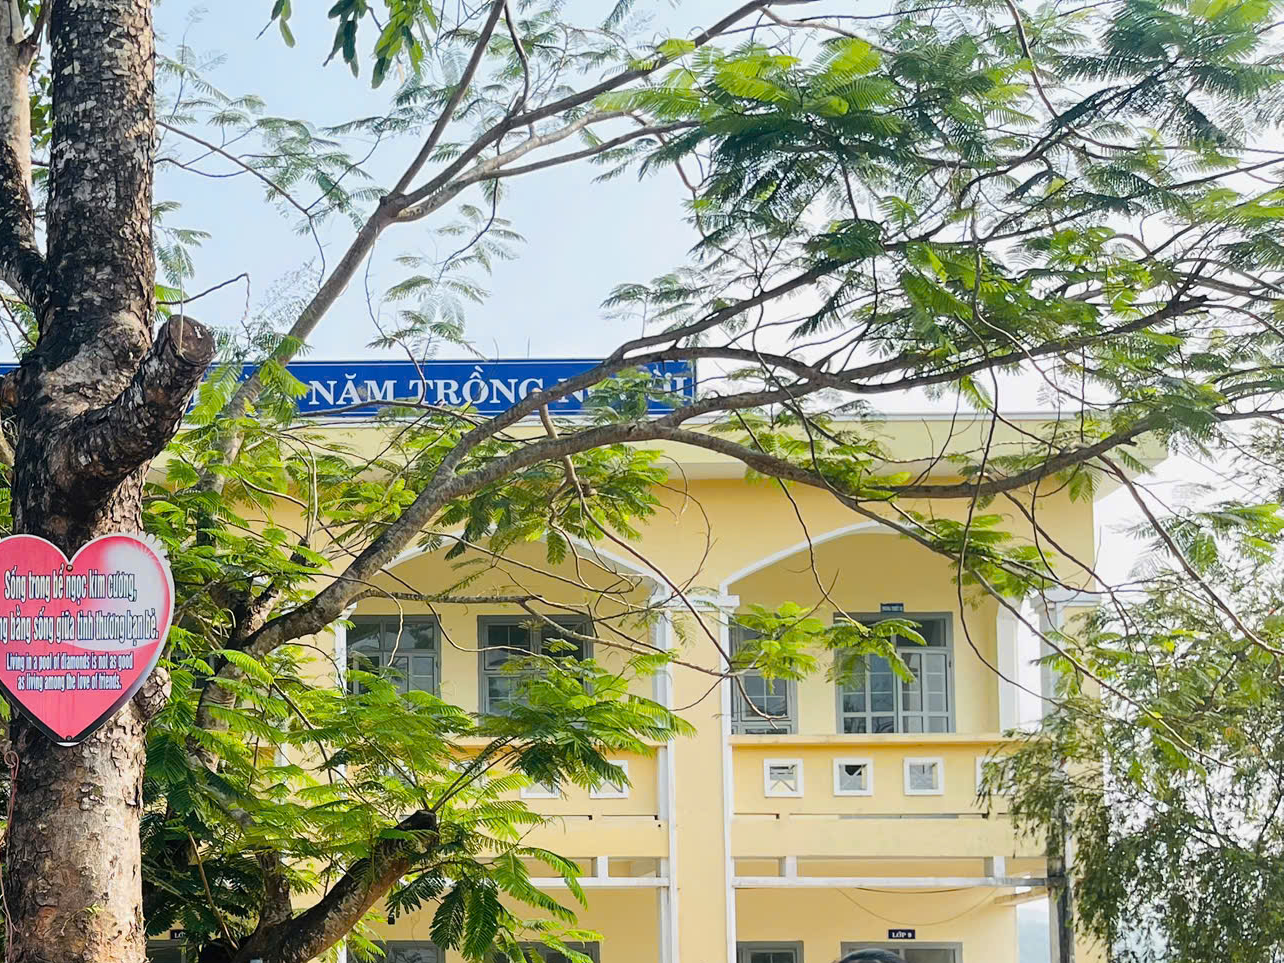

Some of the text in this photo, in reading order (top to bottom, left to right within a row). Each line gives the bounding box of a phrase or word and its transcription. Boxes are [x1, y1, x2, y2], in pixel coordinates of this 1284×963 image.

[308, 374, 396, 405] NĂM
[4, 565, 27, 603] Sống
[28, 570, 51, 603] trong
[65, 574, 87, 606] ngọc
[88, 569, 106, 599] kim
[33, 606, 54, 645] sống
[127, 610, 144, 646] bạn
[6, 652, 25, 672] Living
[25, 652, 32, 670] in
[38, 652, 53, 672] pool
[61, 652, 90, 670] diamonds
[91, 652, 97, 670] is
[98, 652, 109, 670] not
[109, 654, 117, 670] as
[117, 651, 134, 672] good
[17, 675, 25, 690] as
[26, 672, 44, 692] living
[44, 675, 65, 692] among
[65, 672, 76, 690] the
[77, 672, 90, 690] love
[91, 672, 98, 690] of
